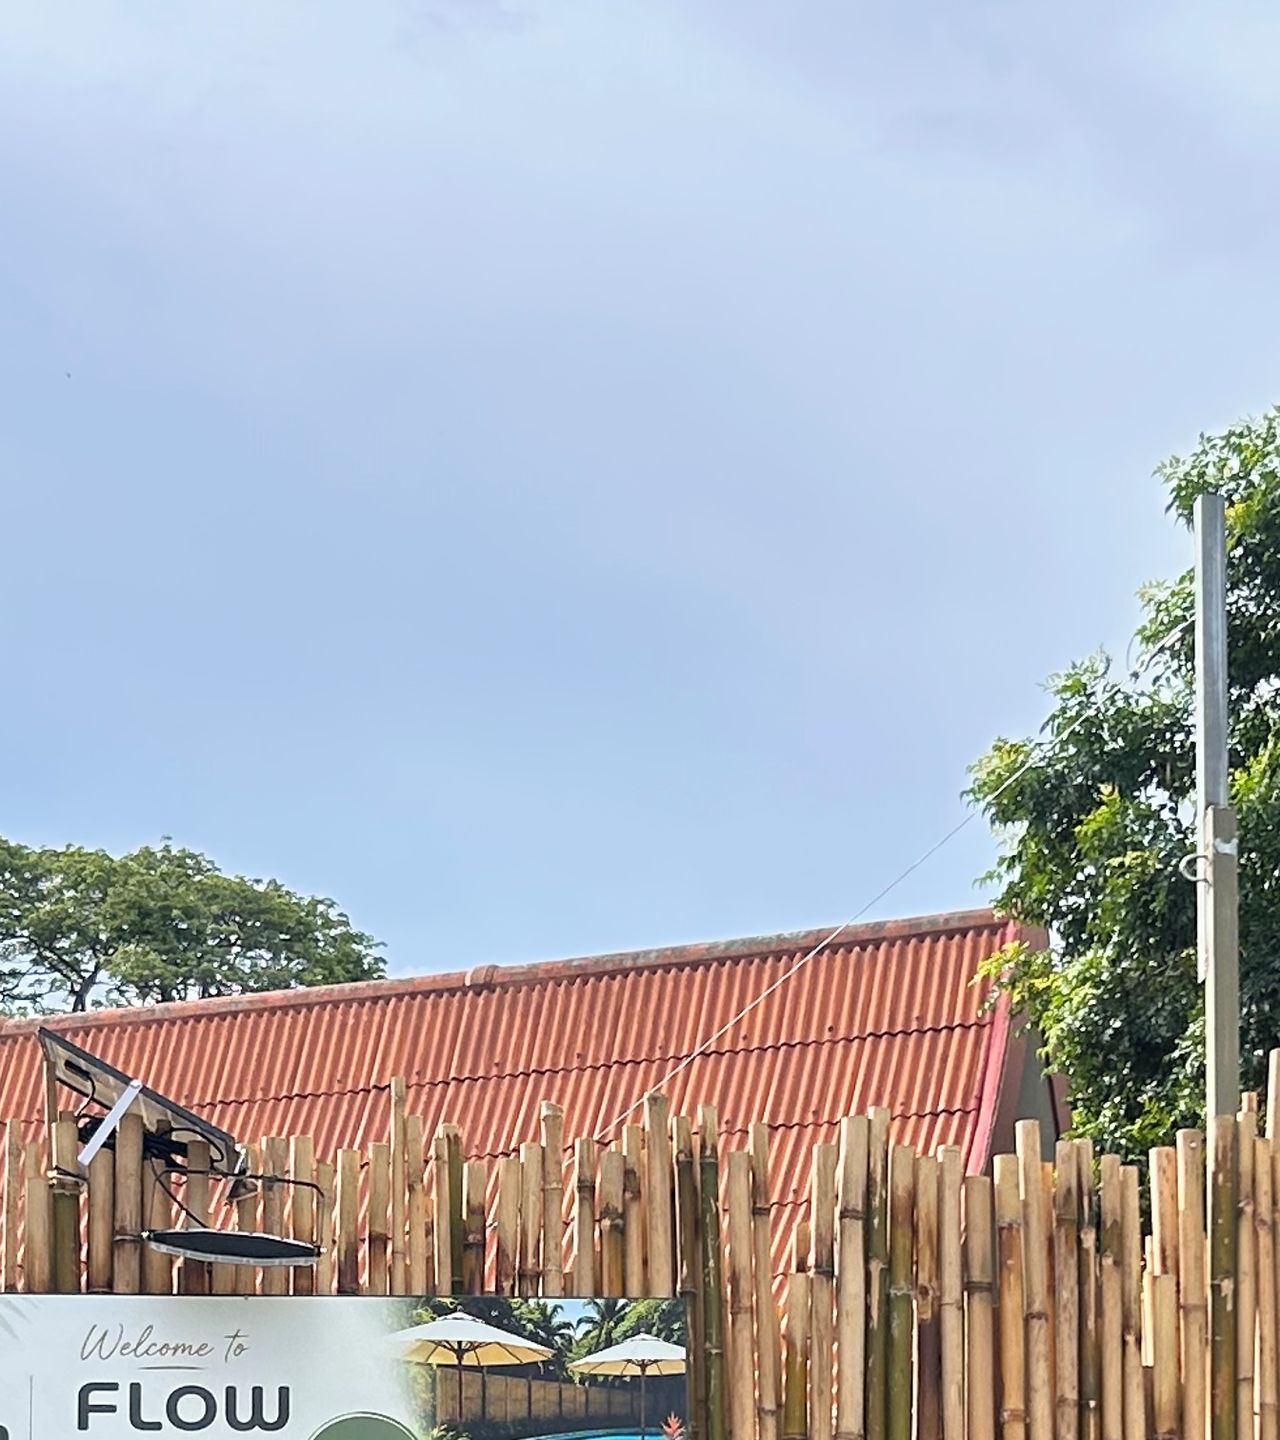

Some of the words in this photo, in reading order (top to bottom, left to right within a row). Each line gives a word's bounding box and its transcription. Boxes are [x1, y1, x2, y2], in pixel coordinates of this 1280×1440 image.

[80, 1323, 215, 1361] Welcome
[224, 1329, 250, 1363] to
[76, 1381, 291, 1432] FLOW
